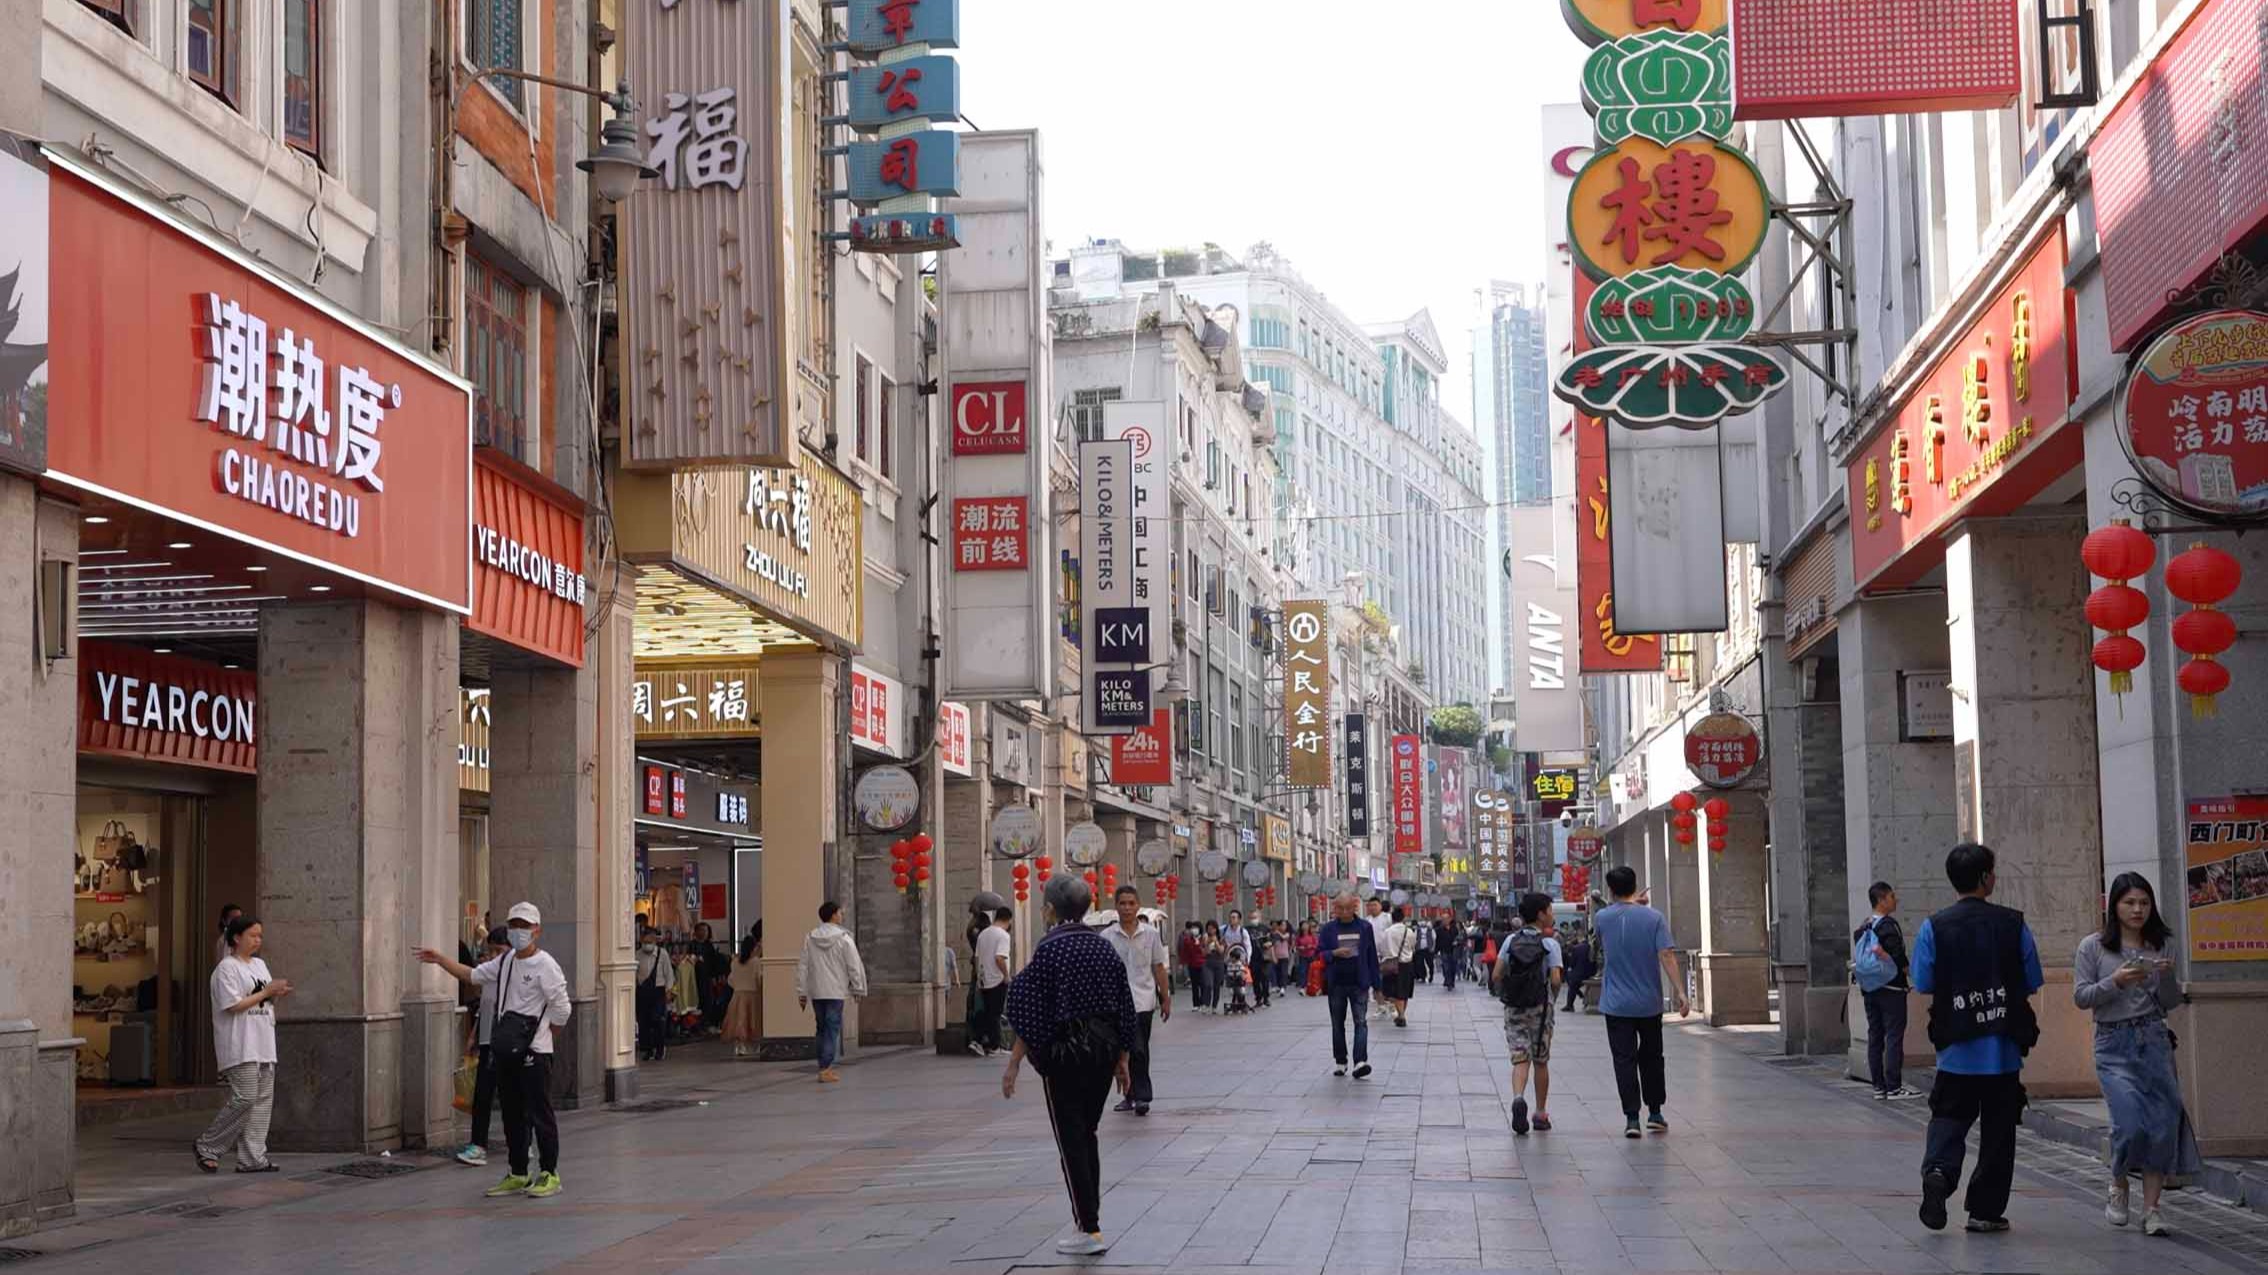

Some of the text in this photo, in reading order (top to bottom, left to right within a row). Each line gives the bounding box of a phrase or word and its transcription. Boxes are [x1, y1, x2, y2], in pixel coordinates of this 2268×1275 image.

[1573, 363, 1773, 388] 老广州手信
[208, 292, 384, 493] 潮热度
[957, 391, 1020, 436] CL
[224, 449, 359, 537] CHAOREDU
[960, 503, 1020, 532] 潮流
[477, 524, 551, 591] YEARCON
[960, 536, 1020, 564] 前线
[1101, 623, 1144, 647] KM
[1527, 602, 1565, 690] ANTA
[852, 684, 866, 712] CP
[1101, 680, 1132, 690] KILO
[96, 671, 254, 744] YEARCON
[1101, 701, 1144, 712] METERS
[1289, 649, 1324, 754] 人民金行
[1121, 731, 1160, 751] 24h
[649, 775, 662, 796] CP
[1533, 773, 1575, 794] 住宿
[1479, 812, 1493, 872] 中国黄金
